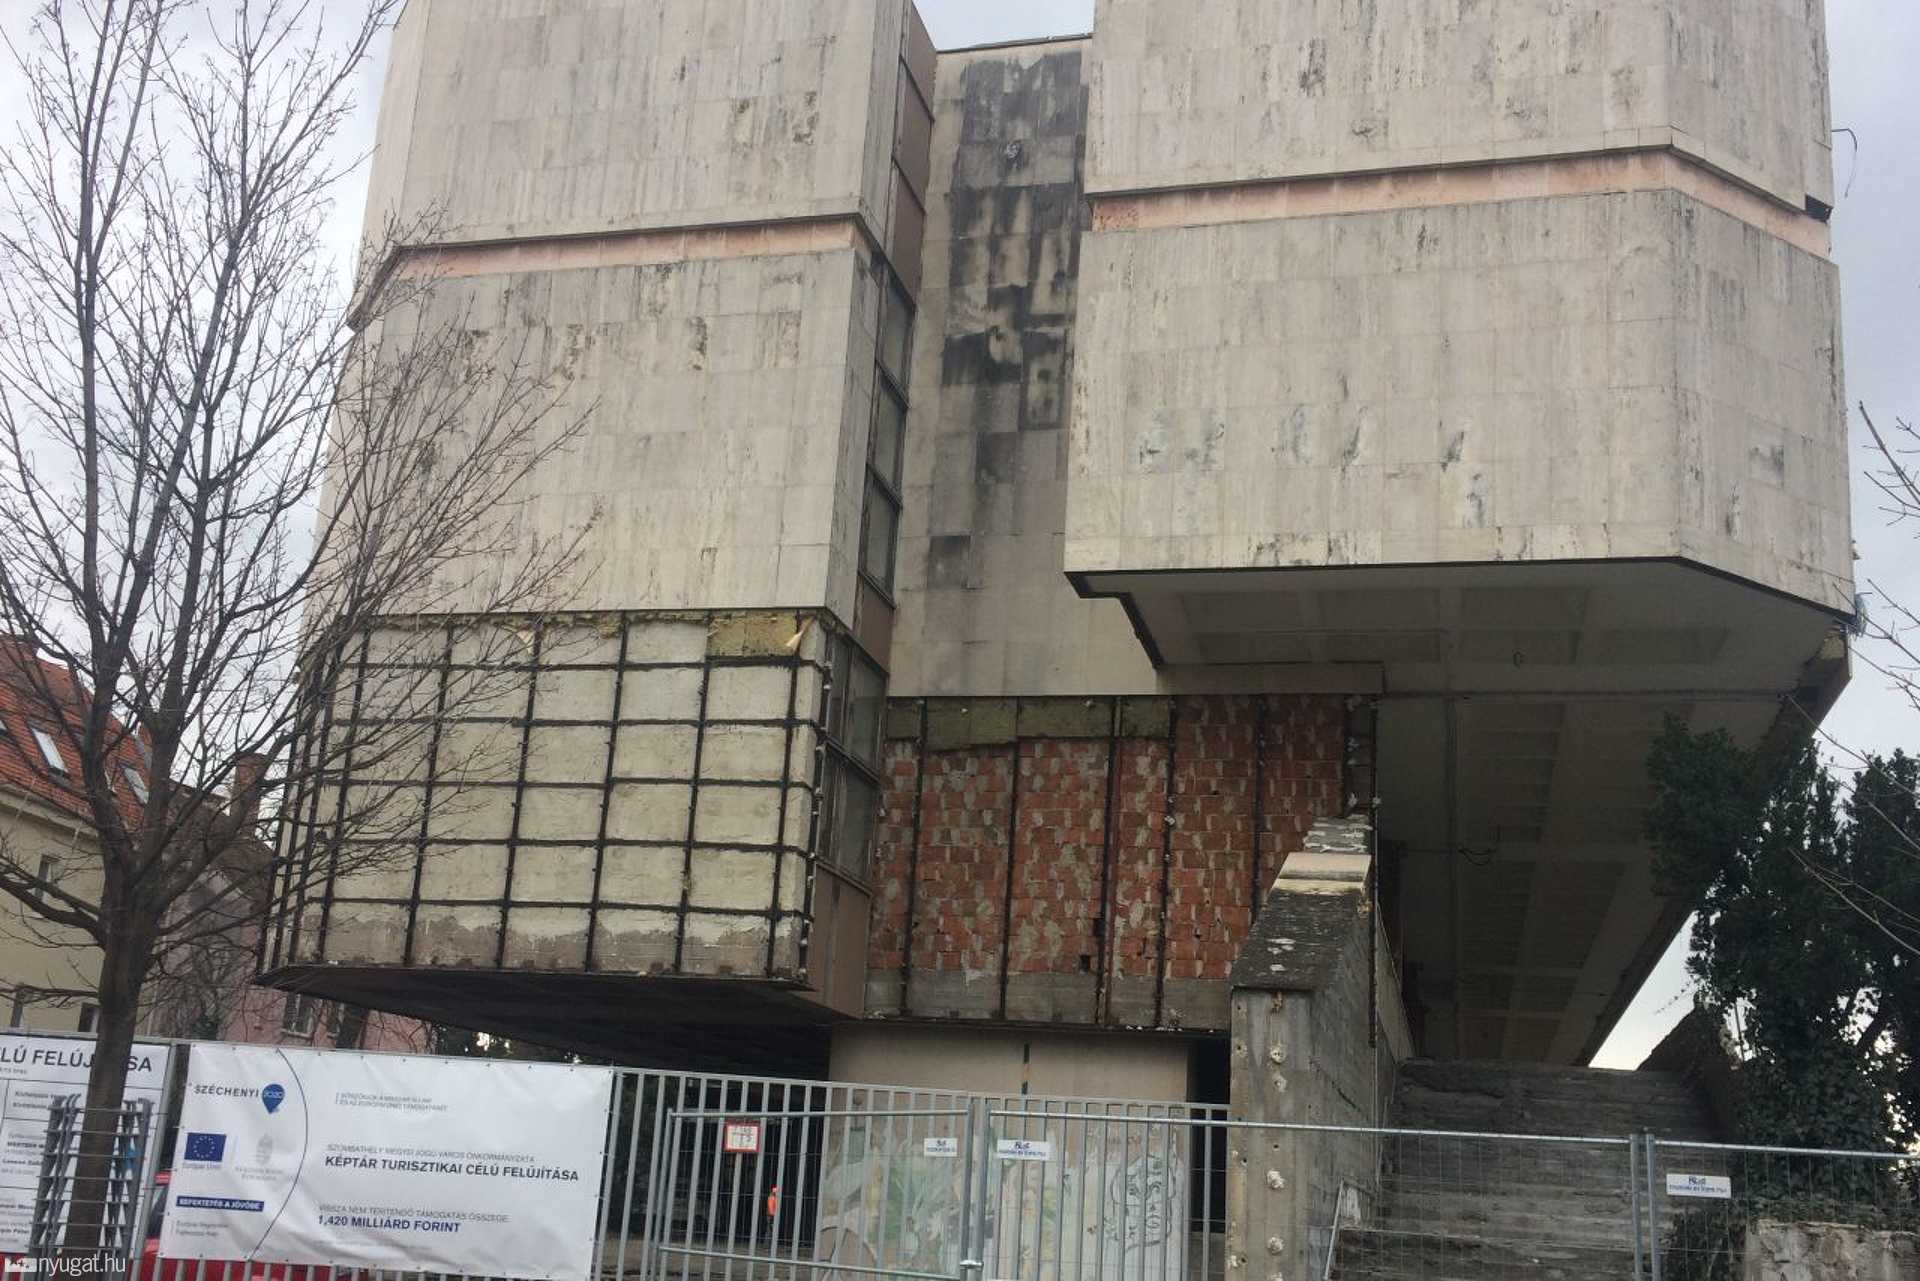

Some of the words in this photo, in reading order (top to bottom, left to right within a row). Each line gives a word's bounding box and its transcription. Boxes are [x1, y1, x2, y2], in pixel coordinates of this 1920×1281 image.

[32, 1048, 152, 1072] FELÚJSA
[193, 1083, 259, 1098] SZÉCHENYI
[325, 1154, 378, 1169] KÉPTÁR
[381, 1158, 463, 1175] TURISZTIKAI
[465, 1162, 499, 1177] CÉLÚ
[503, 1165, 579, 1181] FELÚJÍTÁSA
[351, 1215, 410, 1230] MILLIÁRD
[413, 1220, 461, 1233] FORINT
